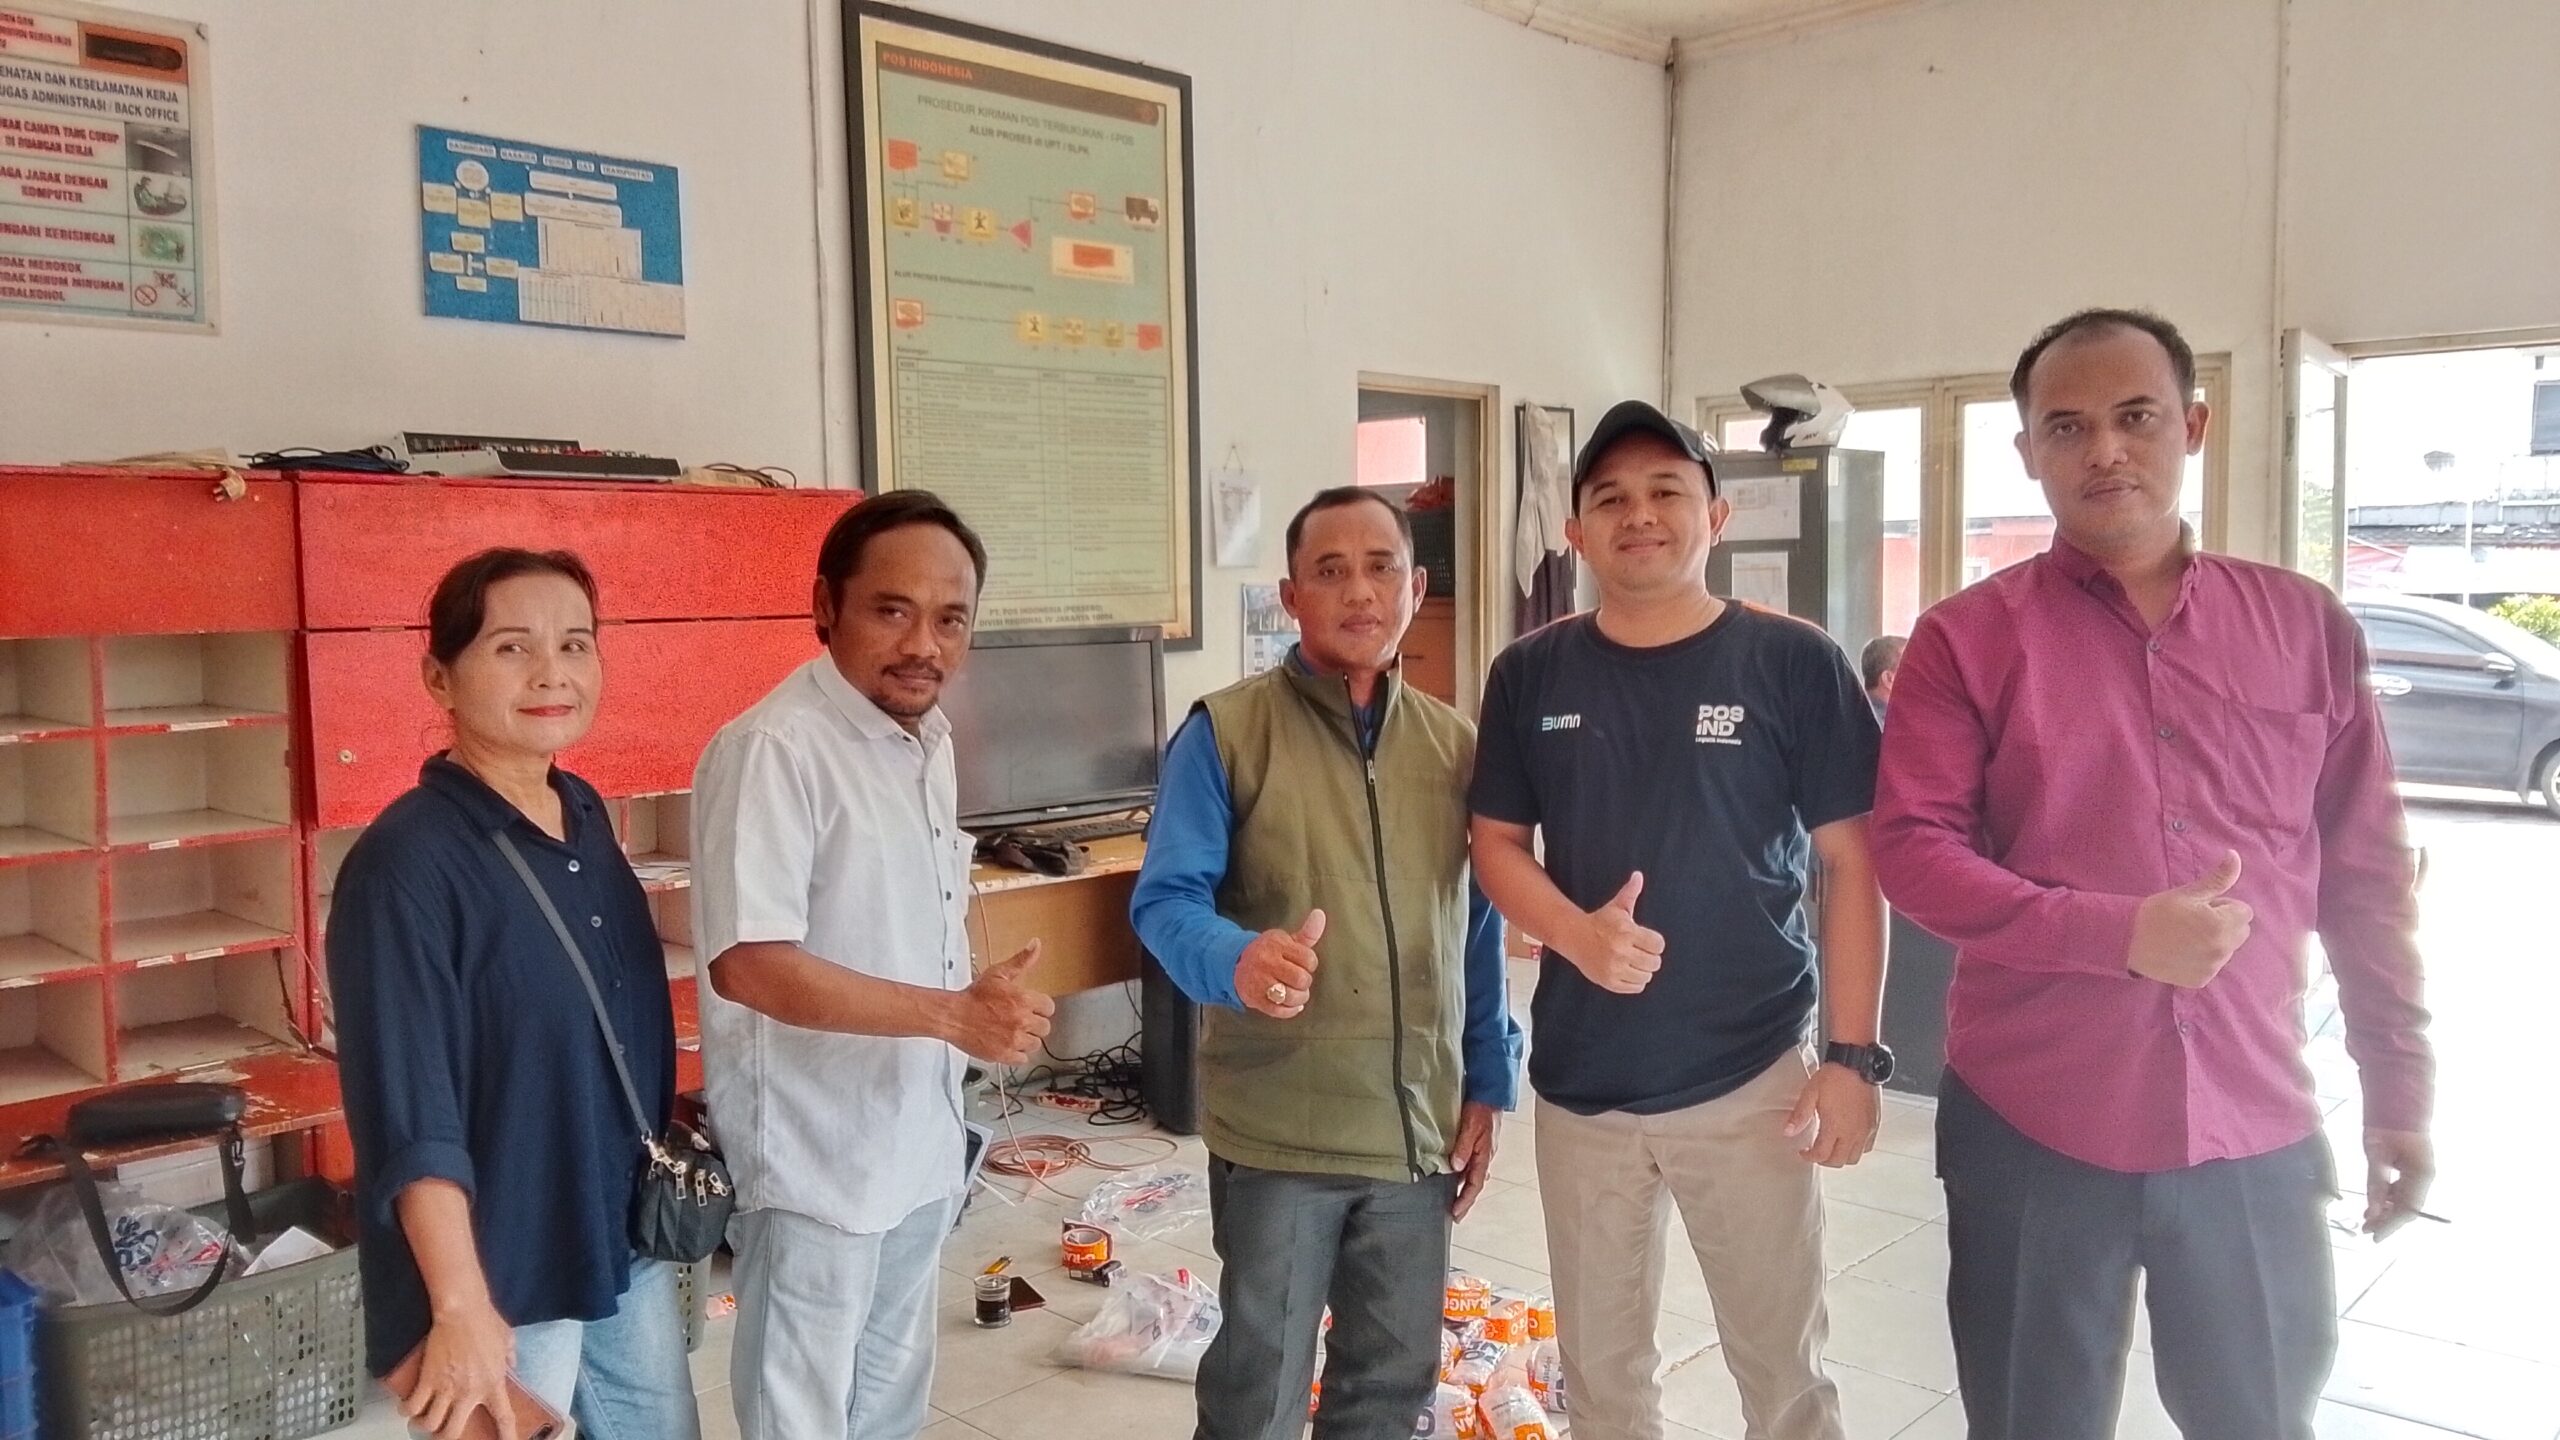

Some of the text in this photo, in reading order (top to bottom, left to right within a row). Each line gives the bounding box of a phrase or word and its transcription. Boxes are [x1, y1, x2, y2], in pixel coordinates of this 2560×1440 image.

[909, 57, 973, 80] INDONESIA
[45, 71, 66, 86] DAN
[69, 75, 143, 98] KESELAMATAN
[146, 89, 179, 103] KERJA
[31, 89, 107, 112] ADMINISTRASI
[115, 104, 142, 117] BACK
[145, 108, 179, 122] OFFICE
[1542, 713, 1581, 731] BUMN
[1698, 704, 1744, 722] POS
